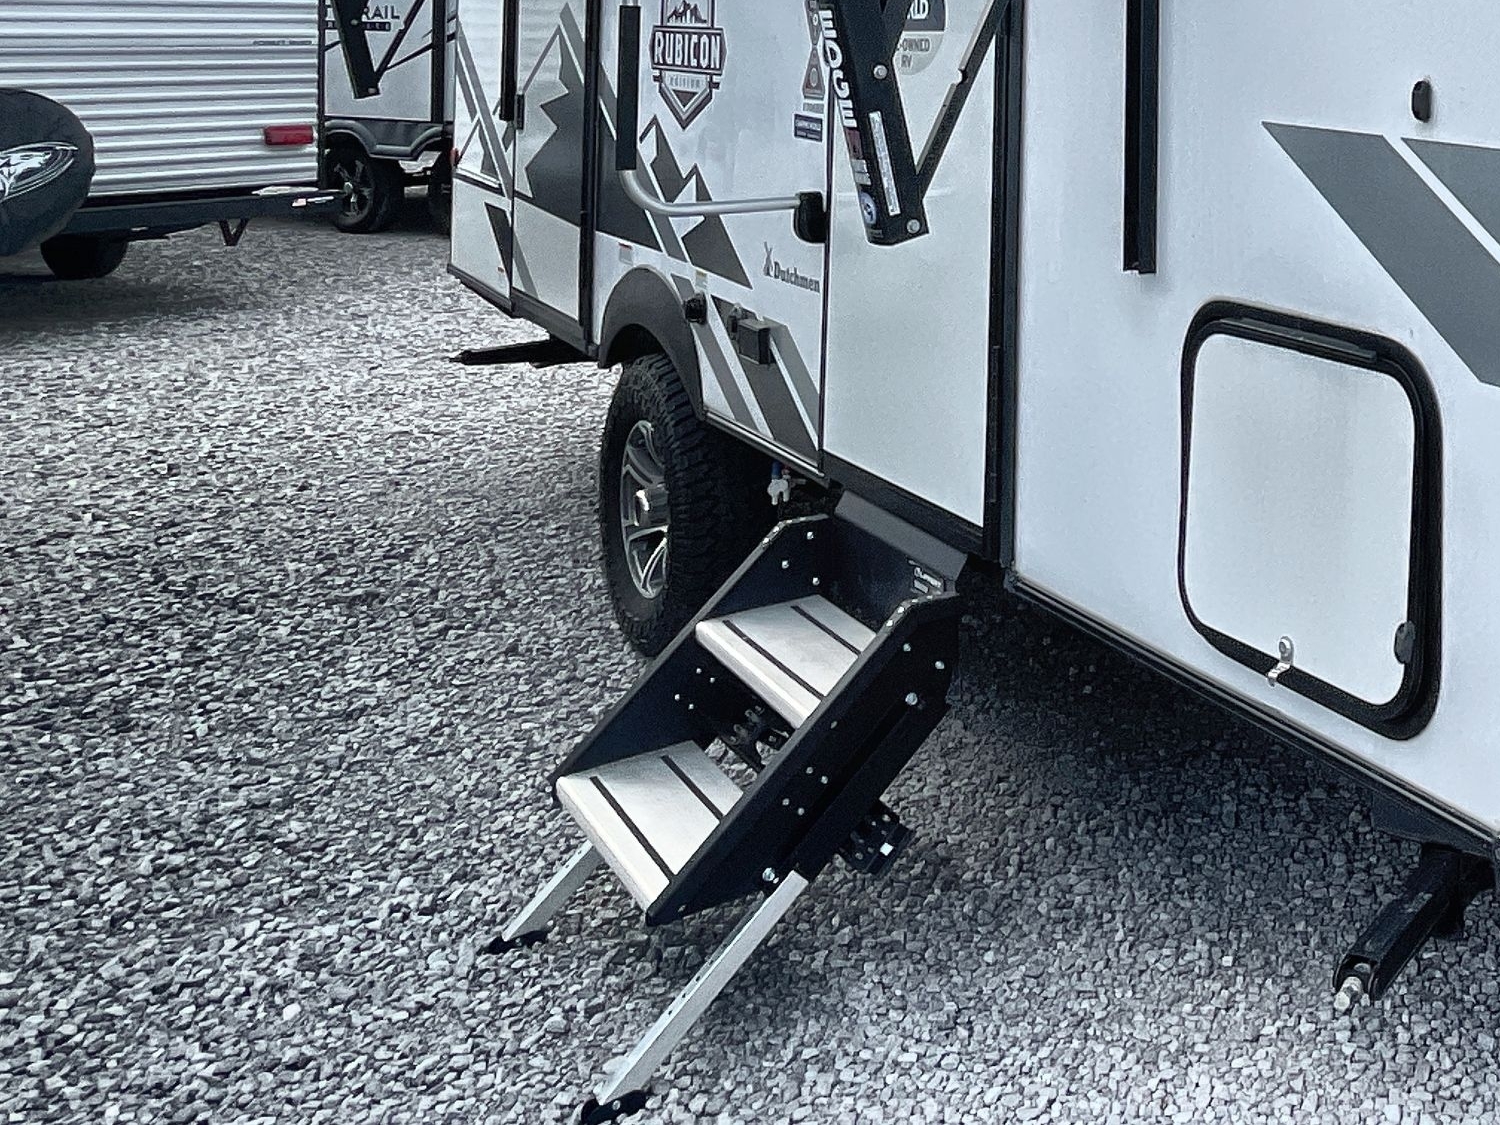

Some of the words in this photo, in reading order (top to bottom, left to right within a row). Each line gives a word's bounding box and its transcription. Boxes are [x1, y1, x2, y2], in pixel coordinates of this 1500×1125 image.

[362, 5, 400, 20] RAIL
[653, 31, 721, 69] RUBICON
[774, 261, 820, 294] Dutchmen
